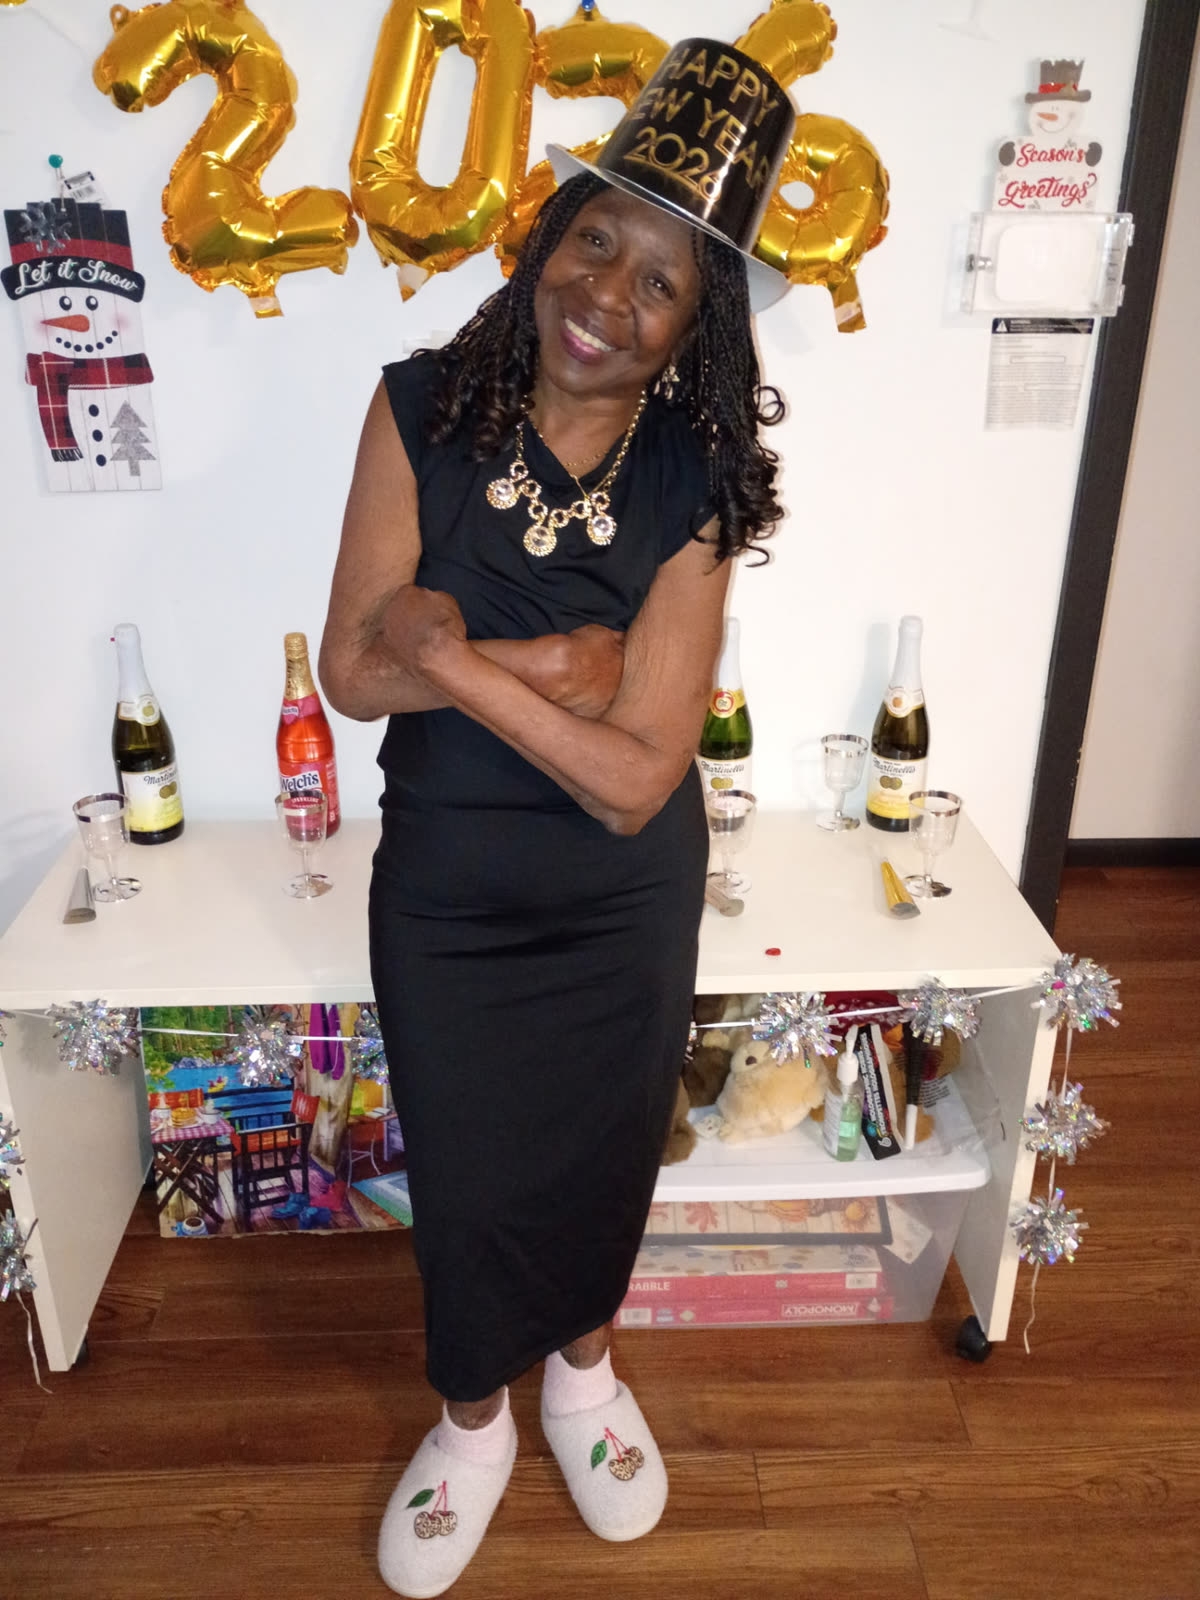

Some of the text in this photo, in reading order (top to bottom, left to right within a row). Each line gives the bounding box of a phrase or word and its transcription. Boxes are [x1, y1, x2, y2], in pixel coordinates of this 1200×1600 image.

[657, 47, 779, 127] HAPPY
[632, 87, 770, 189] EW YEAR
[1016, 143, 1086, 168] Season's
[624, 126, 727, 201] 2026
[998, 172, 1098, 208] Greetings
[15, 258, 139, 295] Let it Snow
[281, 773, 319, 792] Welch's
[628, 1281, 672, 1291] RABBLE
[784, 1303, 857, 1315] MONOPOLY
